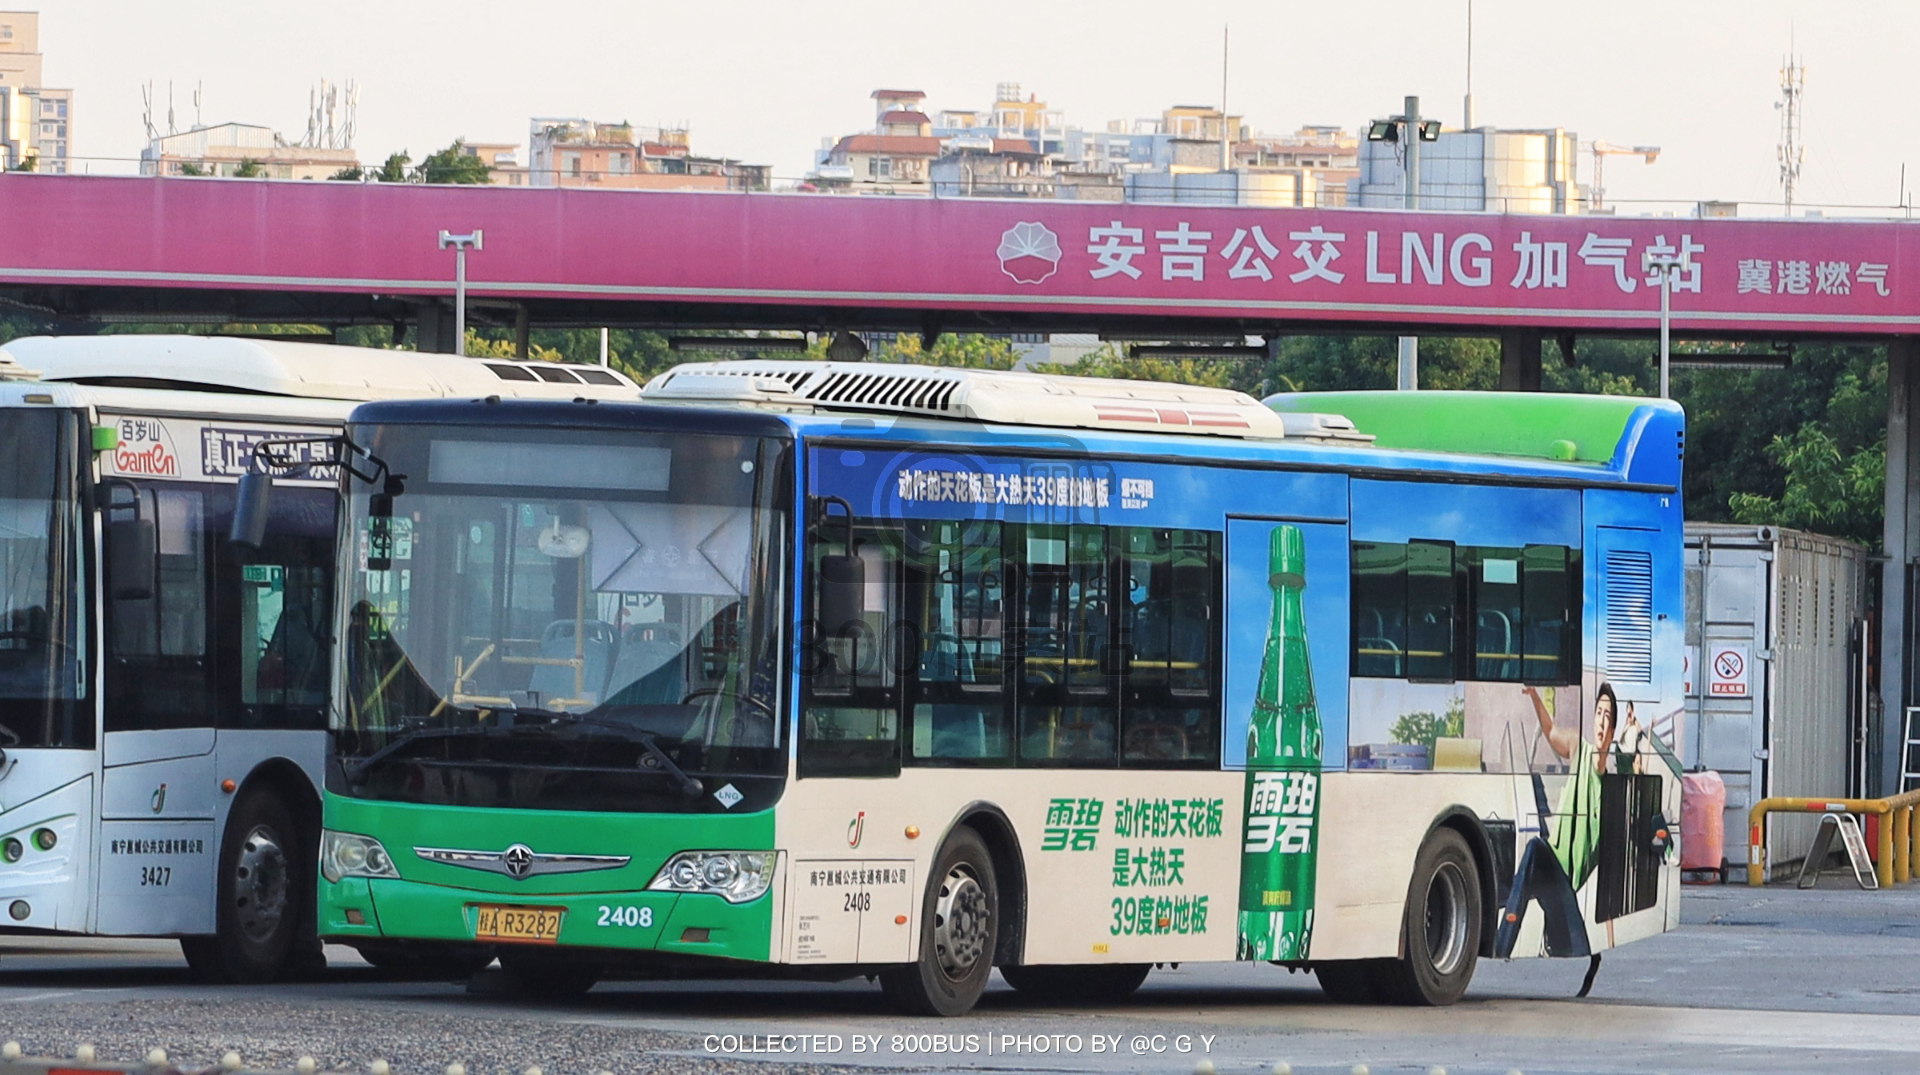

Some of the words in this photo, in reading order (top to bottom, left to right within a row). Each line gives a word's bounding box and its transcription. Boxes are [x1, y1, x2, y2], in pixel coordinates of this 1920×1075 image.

[1088, 220, 1705, 294] 安吉公交LNG加气站
[1737, 259, 1891, 297] 冀港燃气
[121, 419, 160, 442] 百岁山
[114, 440, 175, 476] Ganten
[897, 469, 1110, 509] 动作的天花板是大热天39度的地板
[718, 791, 739, 801] LNG
[1244, 770, 1318, 854] 雪碧
[1039, 796, 1105, 852] 雪碧
[1113, 797, 1224, 839] 动作的天花板
[140, 866, 171, 887] 3427
[810, 868, 907, 887] 南宁邕城公共交通有限公司
[1111, 847, 1185, 888] 是大热天
[596, 905, 653, 928] 2408
[843, 892, 872, 912] 2408
[1109, 895, 1209, 937] 39度的地板
